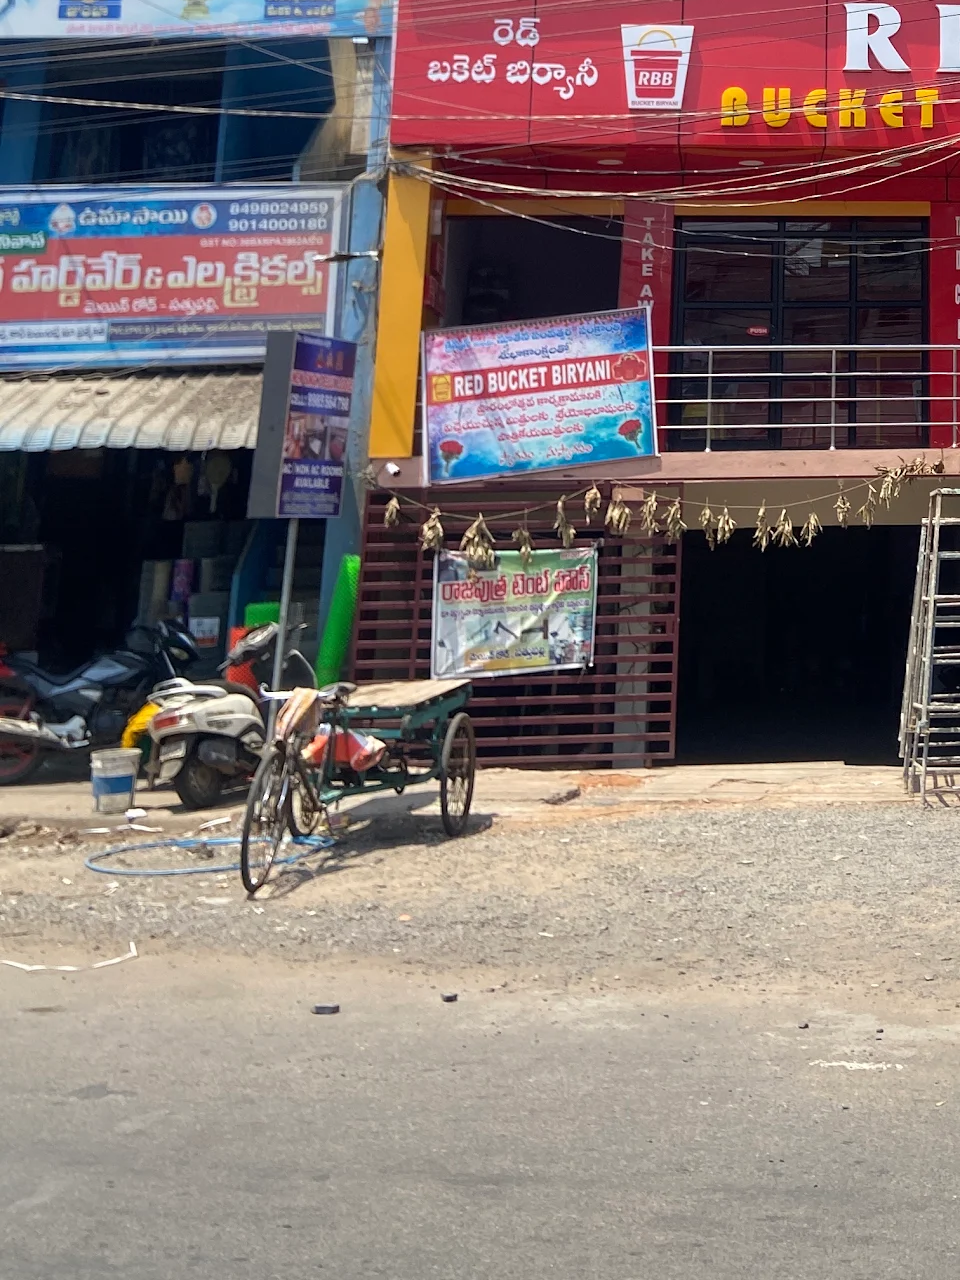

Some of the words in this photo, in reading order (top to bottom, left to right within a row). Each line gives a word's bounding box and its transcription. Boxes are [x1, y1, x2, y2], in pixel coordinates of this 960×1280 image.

[492, 17, 541, 47] రెడ్
[638, 71, 673, 86] RBB
[720, 85, 939, 130] BUCKET
[454, 373, 484, 398] RED
[488, 365, 548, 394] BUCKET
[551, 359, 611, 386] BIRYANI
